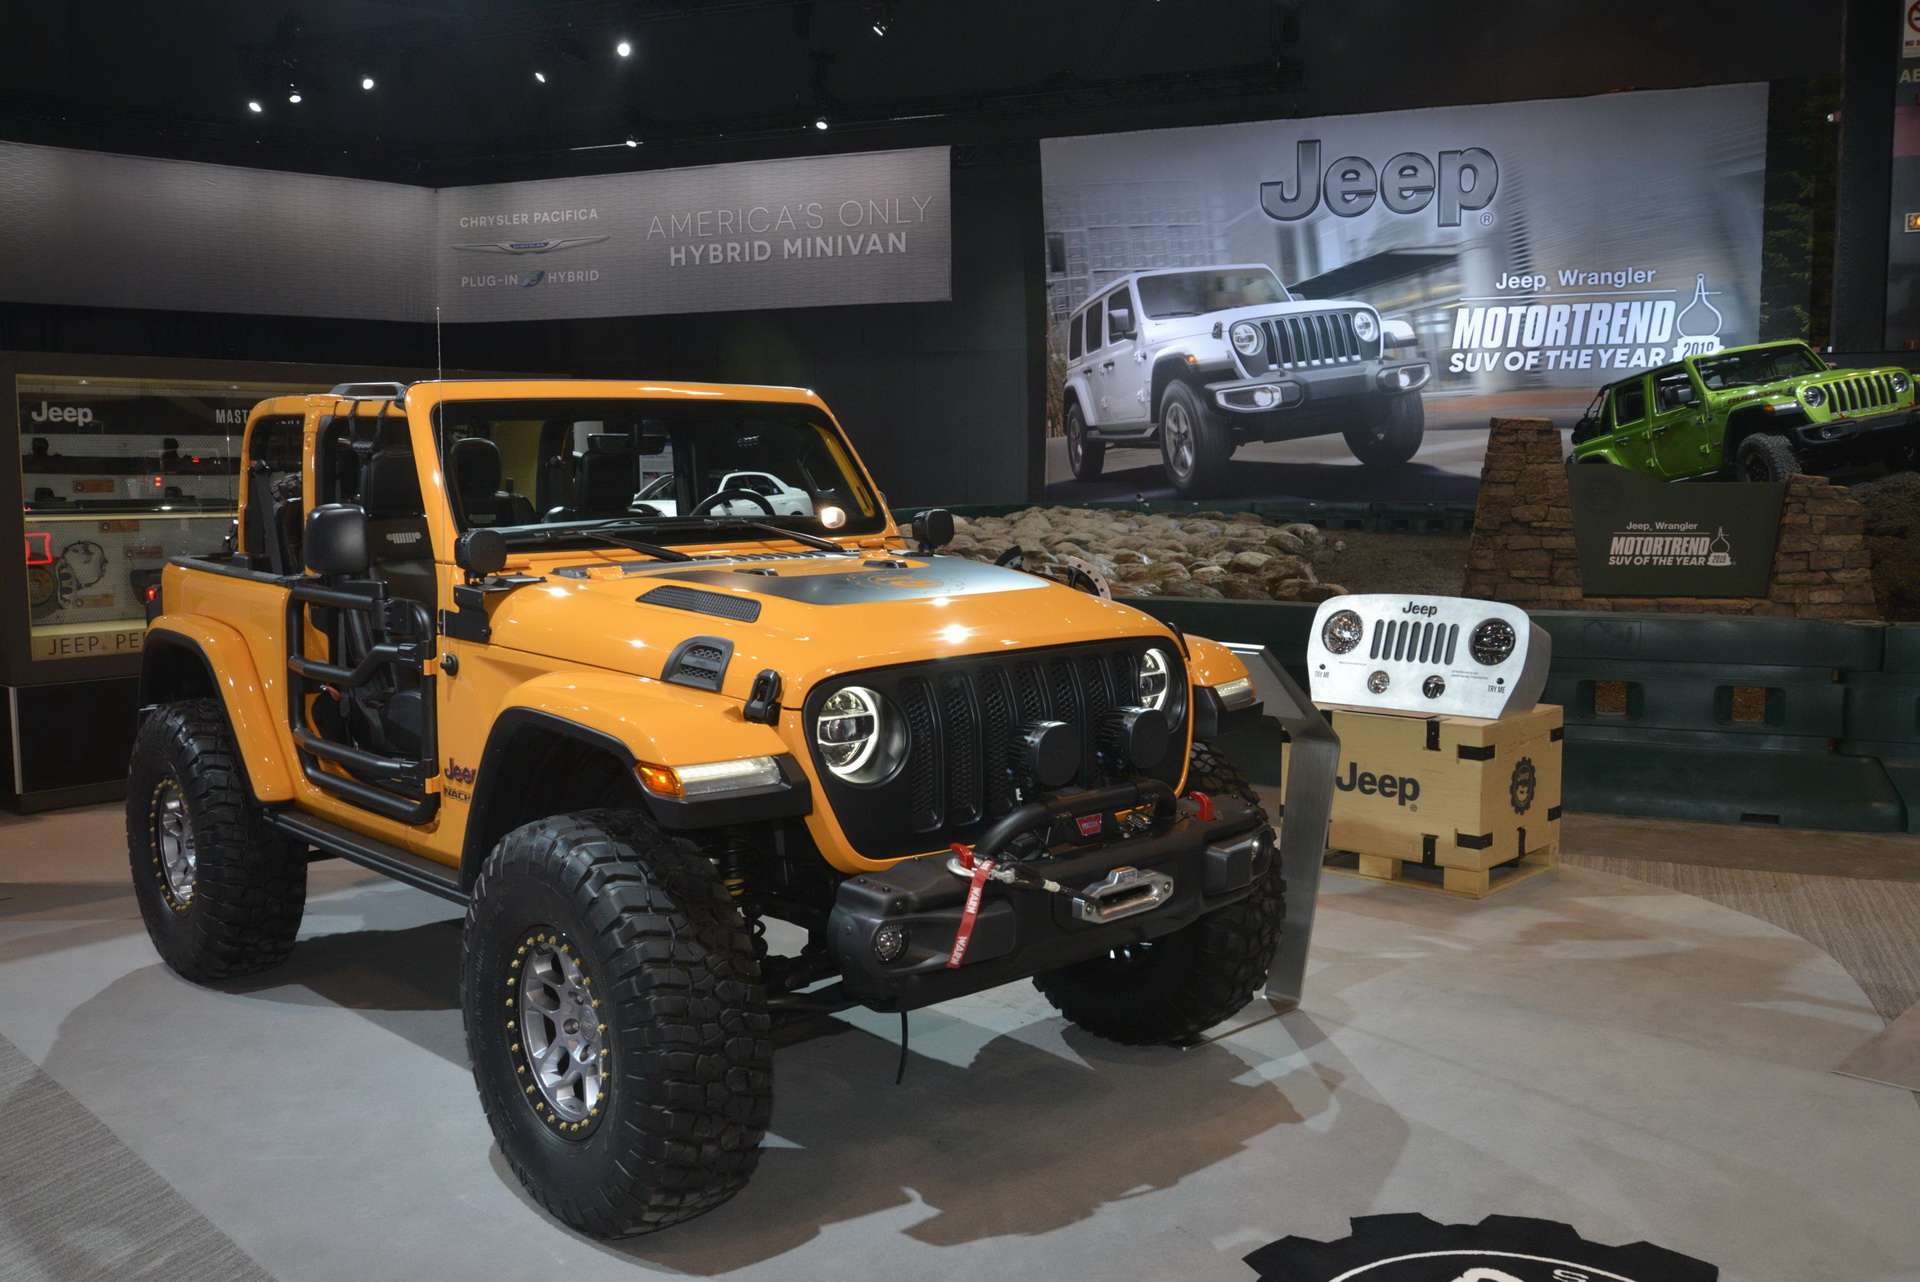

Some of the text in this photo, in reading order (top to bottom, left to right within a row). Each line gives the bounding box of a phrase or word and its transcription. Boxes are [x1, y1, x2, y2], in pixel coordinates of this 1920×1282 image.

[1260, 139, 1499, 228] Jeep
[459, 208, 599, 228] CHRYSLER PACIFICA
[647, 195, 932, 241] AMERICA'S ONLY
[670, 232, 907, 267] HYBRID MINIVAN
[461, 274, 518, 288] PLUG-IN
[548, 270, 600, 283] HYBRID
[1496, 267, 1656, 292] Jeep Wrangler
[1451, 300, 1677, 350] MOTORTREND
[1449, 347, 1665, 373] SUV OF THE YEAR
[31, 401, 93, 426] Jeep
[215, 409, 251, 424] MAST
[1626, 521, 1698, 531] Jeep Wrangler
[1609, 536, 1711, 556] MOTORTREND
[1608, 556, 1706, 566] SUV OF THE YEAR
[1402, 601, 1438, 618] Jeep
[48, 636, 100, 656] JEEP
[1323, 671, 1330, 679] ME
[1487, 684, 1506, 694] TRY ME
[1335, 762, 1420, 806] Jeep
[966, 886, 981, 915] WARN
[949, 936, 968, 965] WARN
